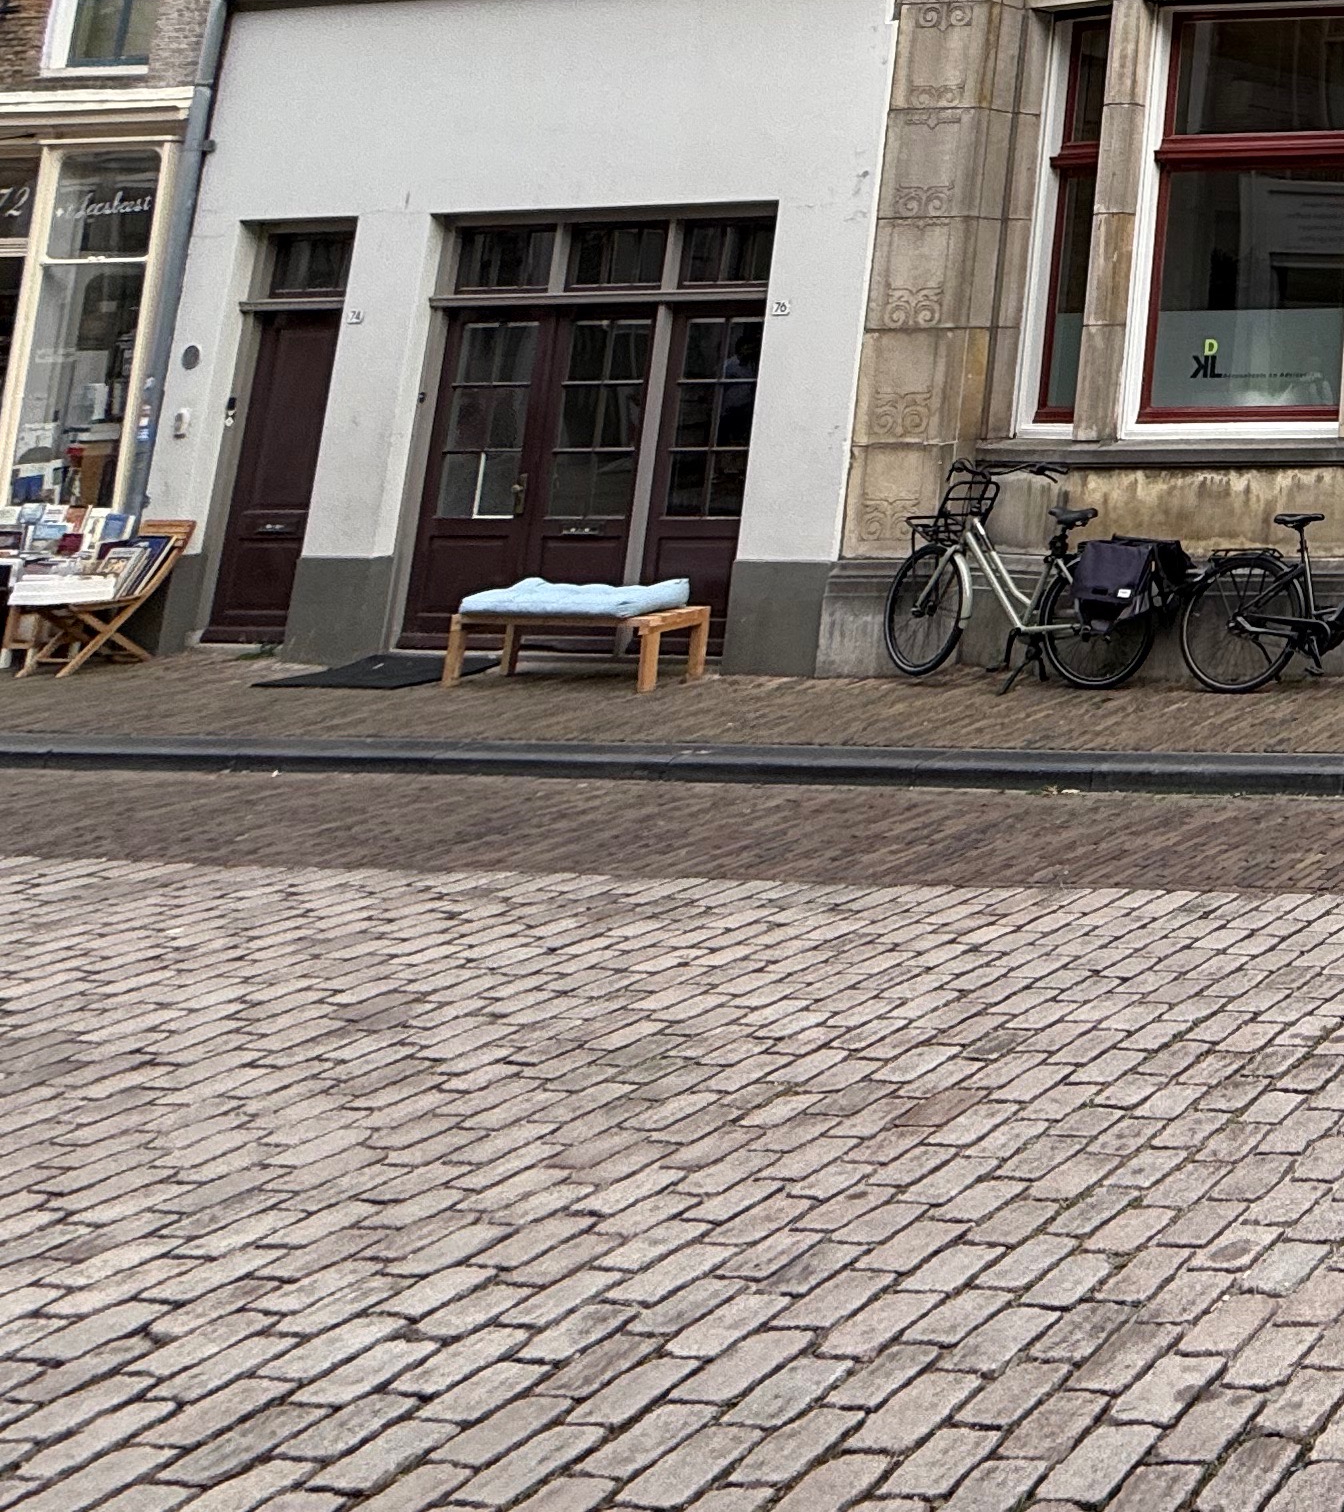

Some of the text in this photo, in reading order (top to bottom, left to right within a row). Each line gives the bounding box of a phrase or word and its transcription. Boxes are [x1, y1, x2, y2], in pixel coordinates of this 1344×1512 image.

[774, 301, 787, 313] 76
[350, 310, 361, 320] 74
[1204, 339, 1218, 356] D
